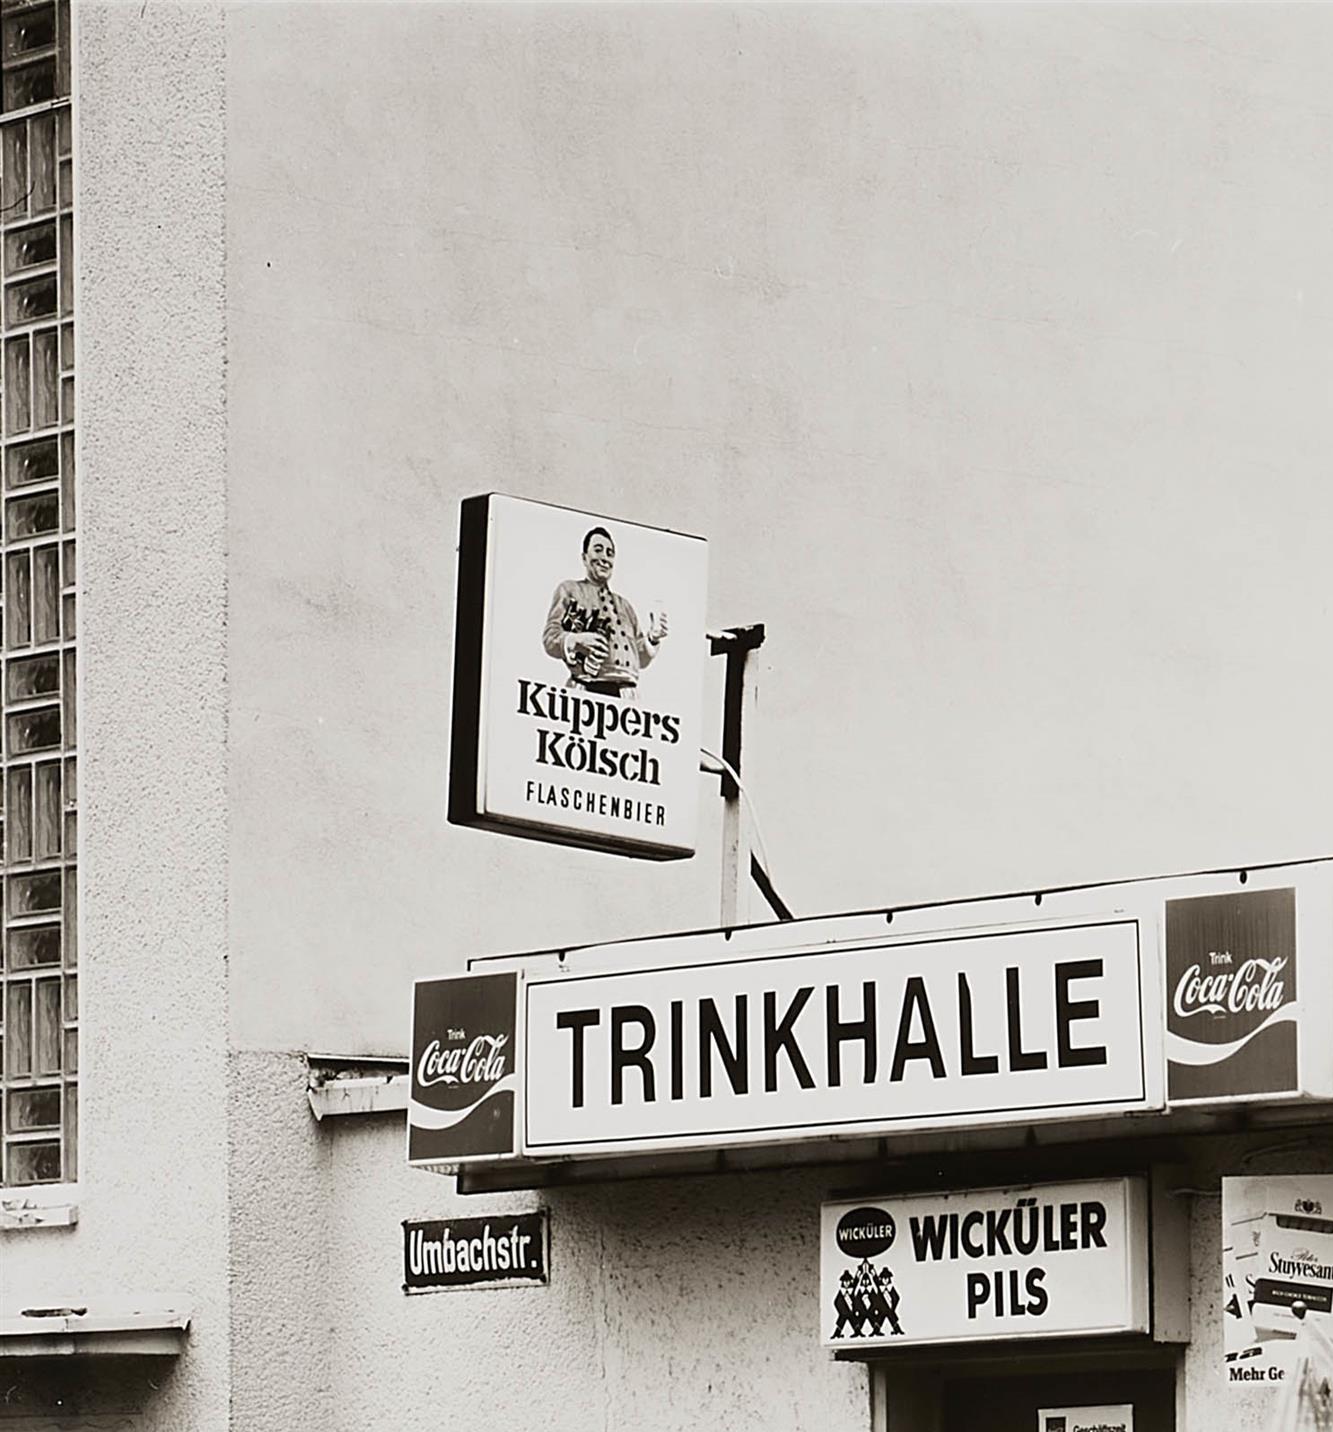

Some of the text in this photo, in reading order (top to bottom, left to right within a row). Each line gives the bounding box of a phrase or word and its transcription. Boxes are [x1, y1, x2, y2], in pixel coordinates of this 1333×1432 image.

[517, 678, 681, 745] Küppers
[535, 729, 662, 786] Kölsch
[525, 780, 667, 827] FLASCHENBIER
[1173, 956, 1289, 1018] Coca-Cola
[417, 1033, 510, 1087] Coca-Cola
[556, 958, 1109, 1110] TRINKHALLE
[408, 1226, 541, 1280] Umbachstr.
[837, 1223, 894, 1245] WICKÜLER
[908, 1196, 1109, 1264] WICKÜLER
[965, 1265, 1051, 1321] PILS
[1229, 1367, 1266, 1382] Mehr
